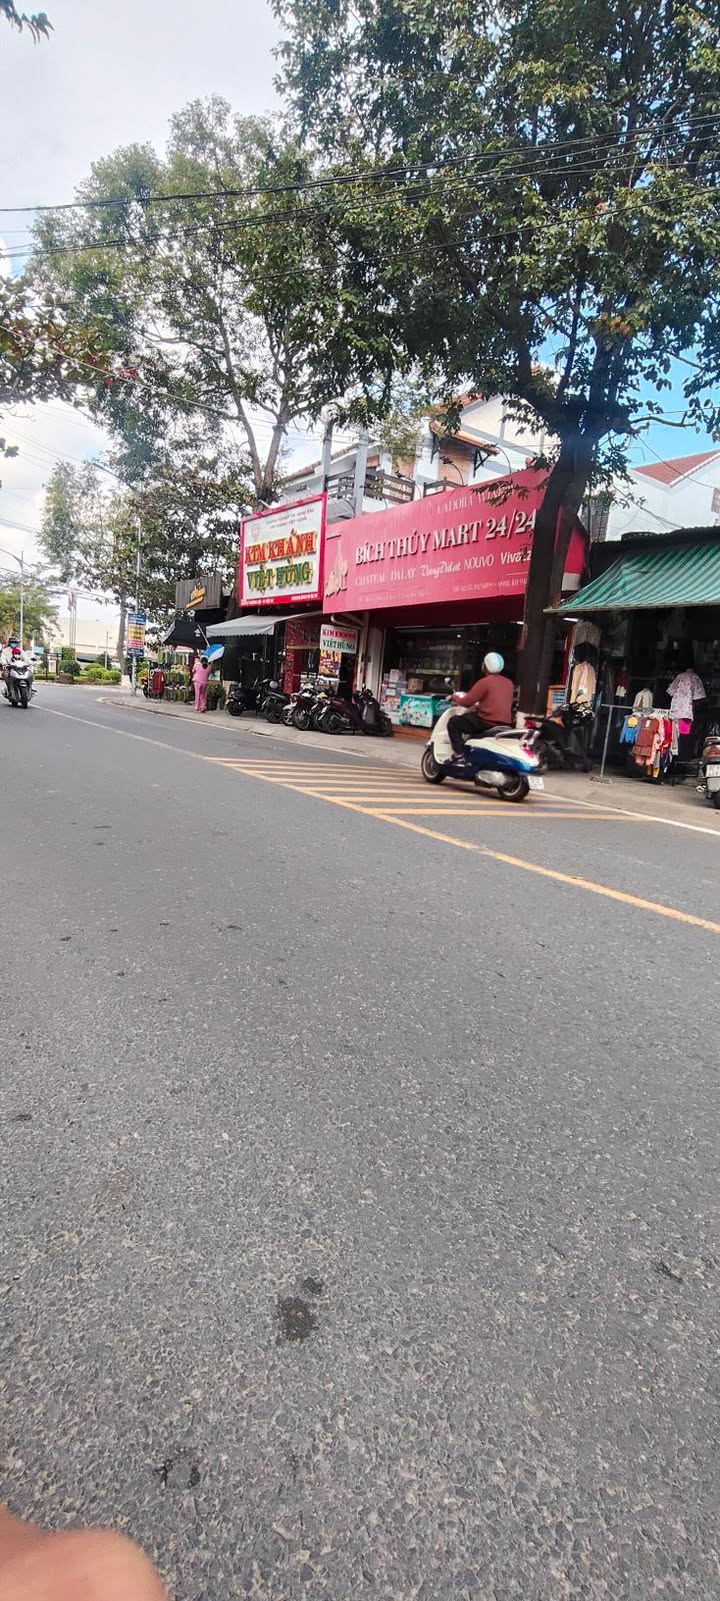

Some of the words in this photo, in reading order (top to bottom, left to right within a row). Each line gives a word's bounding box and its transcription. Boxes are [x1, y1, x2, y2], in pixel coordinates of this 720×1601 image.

[245, 543, 268, 566] KIM
[269, 528, 317, 560] KHÁNH
[355, 542, 386, 566] BÍCH
[388, 529, 431, 559] THÚY
[432, 520, 482, 551] MART
[485, 508, 537, 540] 24/24
